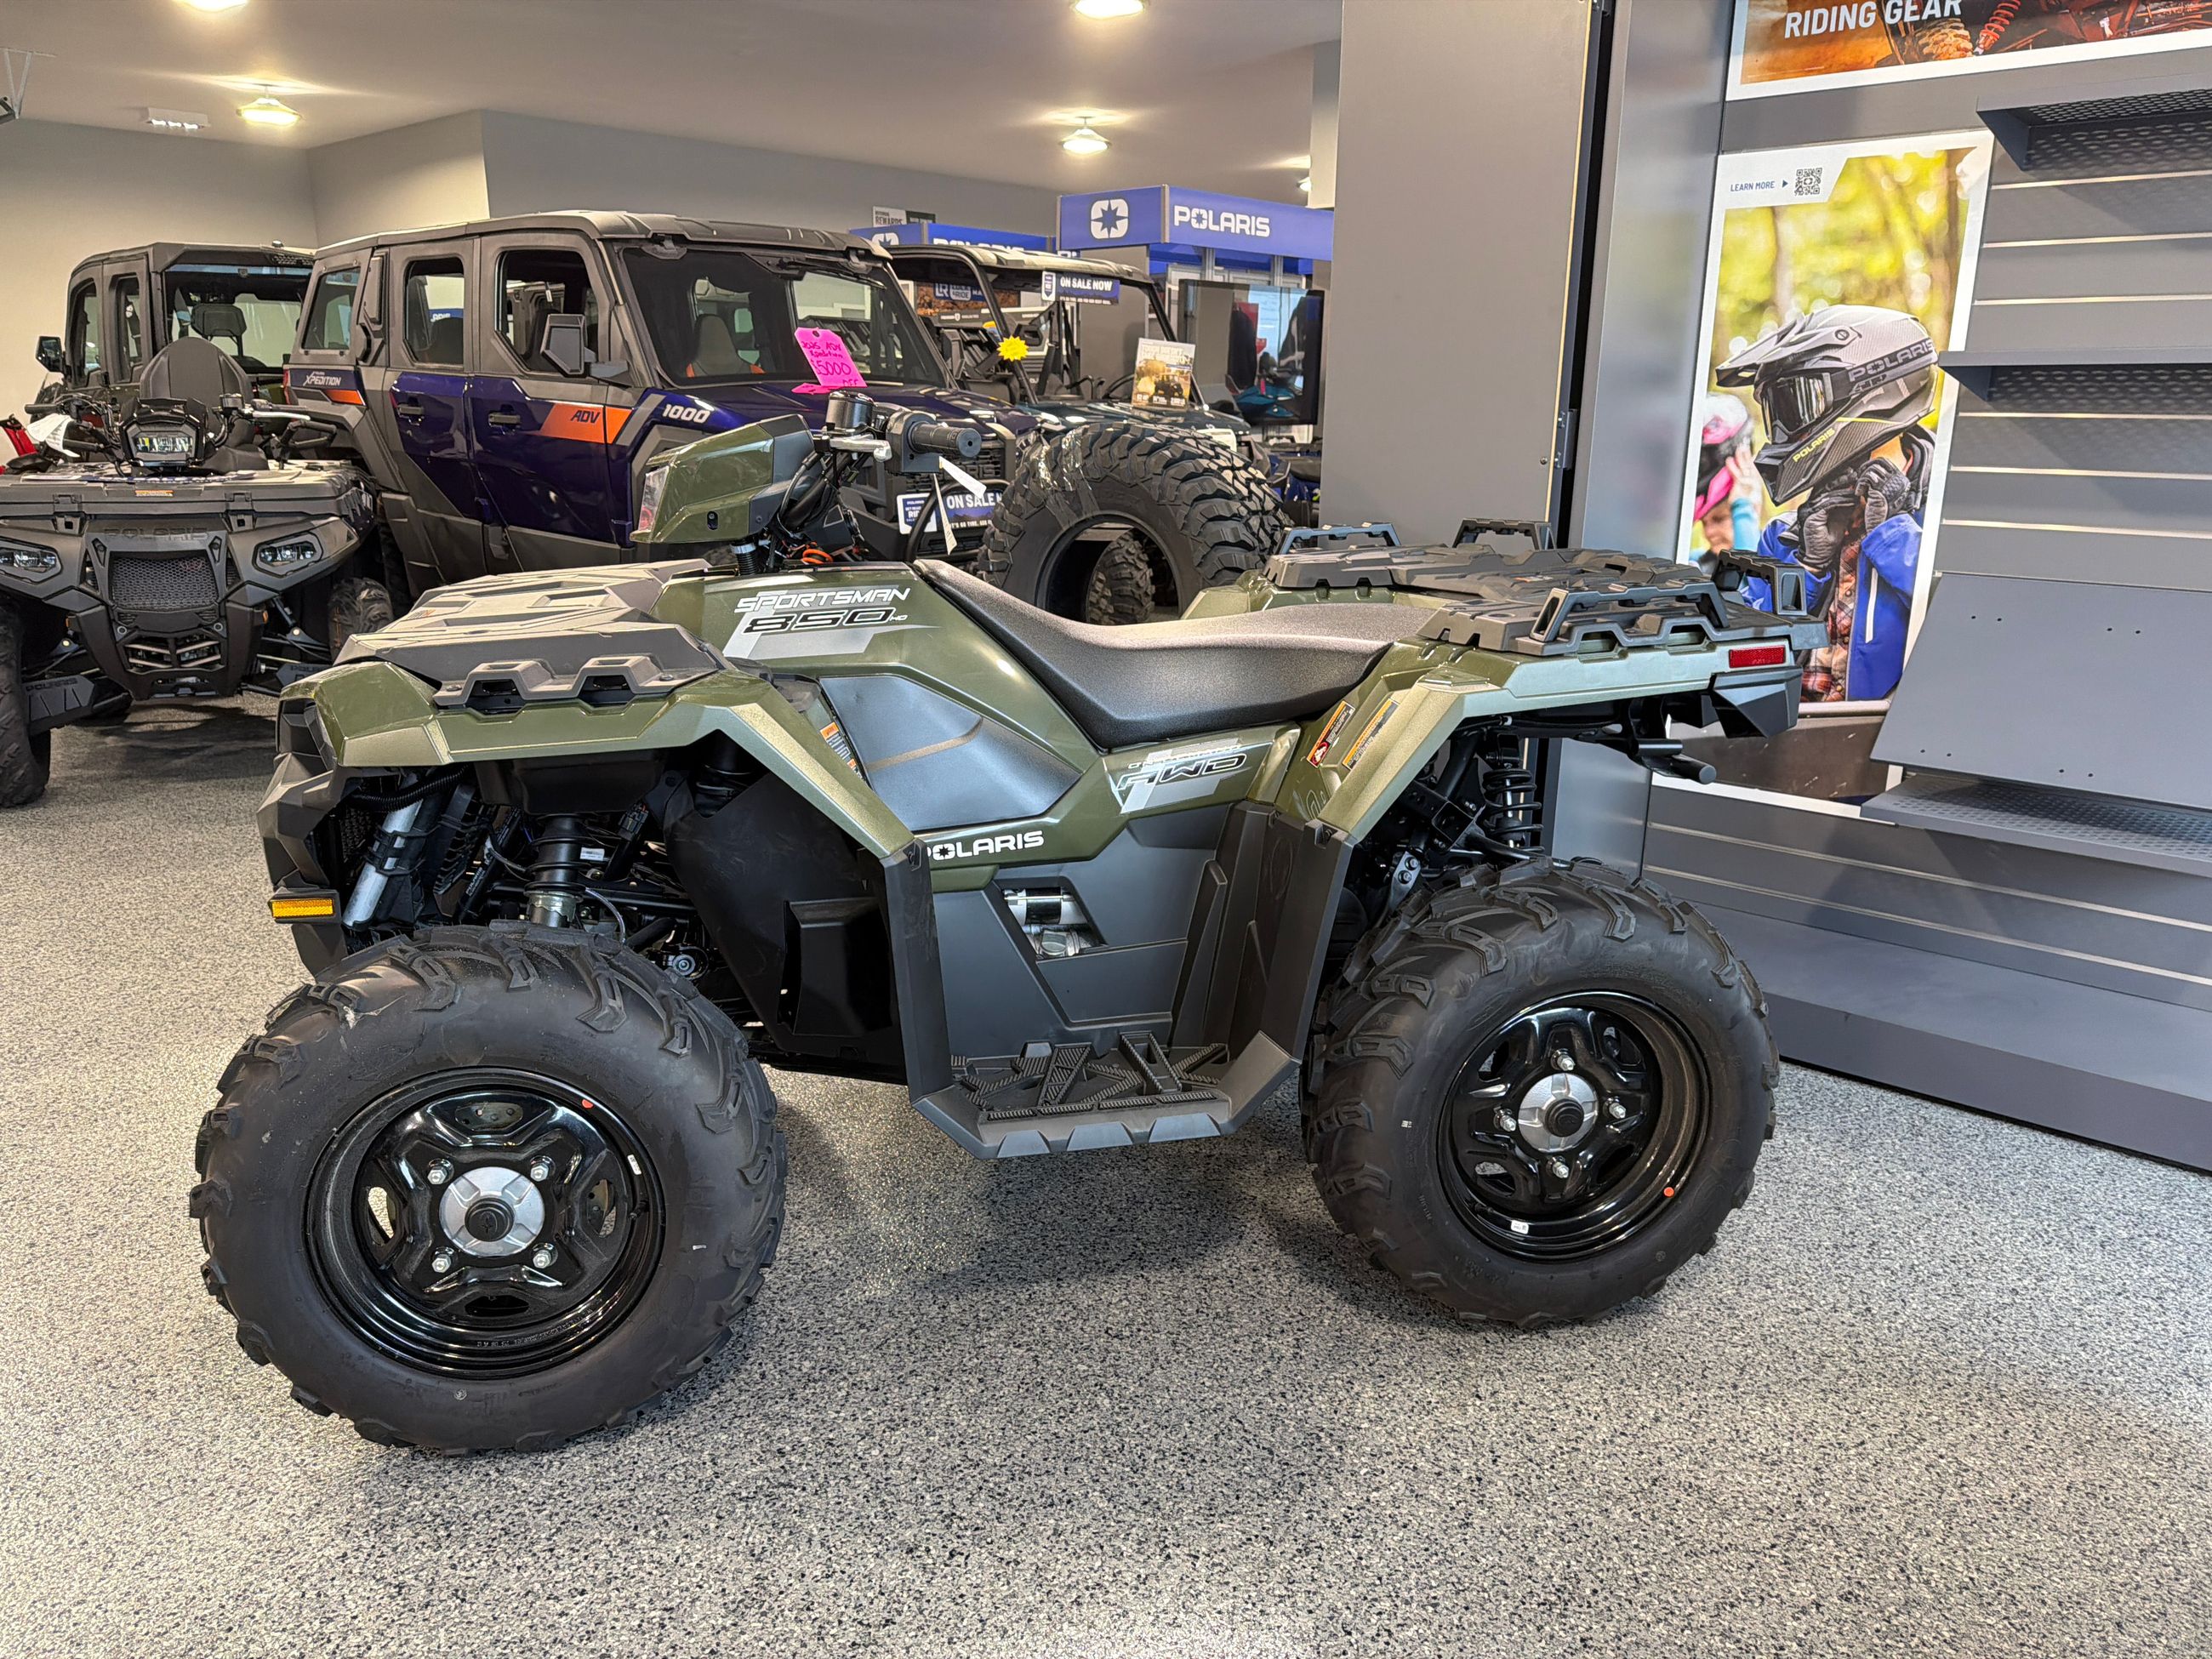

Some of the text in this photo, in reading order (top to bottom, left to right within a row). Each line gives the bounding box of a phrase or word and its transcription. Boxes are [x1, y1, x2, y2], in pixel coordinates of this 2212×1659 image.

[1784, 0, 1962, 39] RIDING GEAR
[1730, 180, 1776, 192] LEARN MORE
[1173, 205, 1270, 237] POLARIS
[1060, 276, 1070, 287] ON
[1072, 277, 1092, 289] SALE
[1092, 281, 1113, 291] NOW
[1847, 339, 1935, 382] POLARIS
[303, 373, 341, 386] XPEDITION
[570, 410, 601, 424] ADV
[663, 404, 710, 424] 1000
[1793, 427, 1836, 463] POLARIS
[946, 494, 965, 510] ON
[966, 493, 995, 509] SALE
[734, 588, 911, 613] SPORTSMAN
[741, 607, 897, 635] 850
[1114, 753, 1247, 791] AWD
